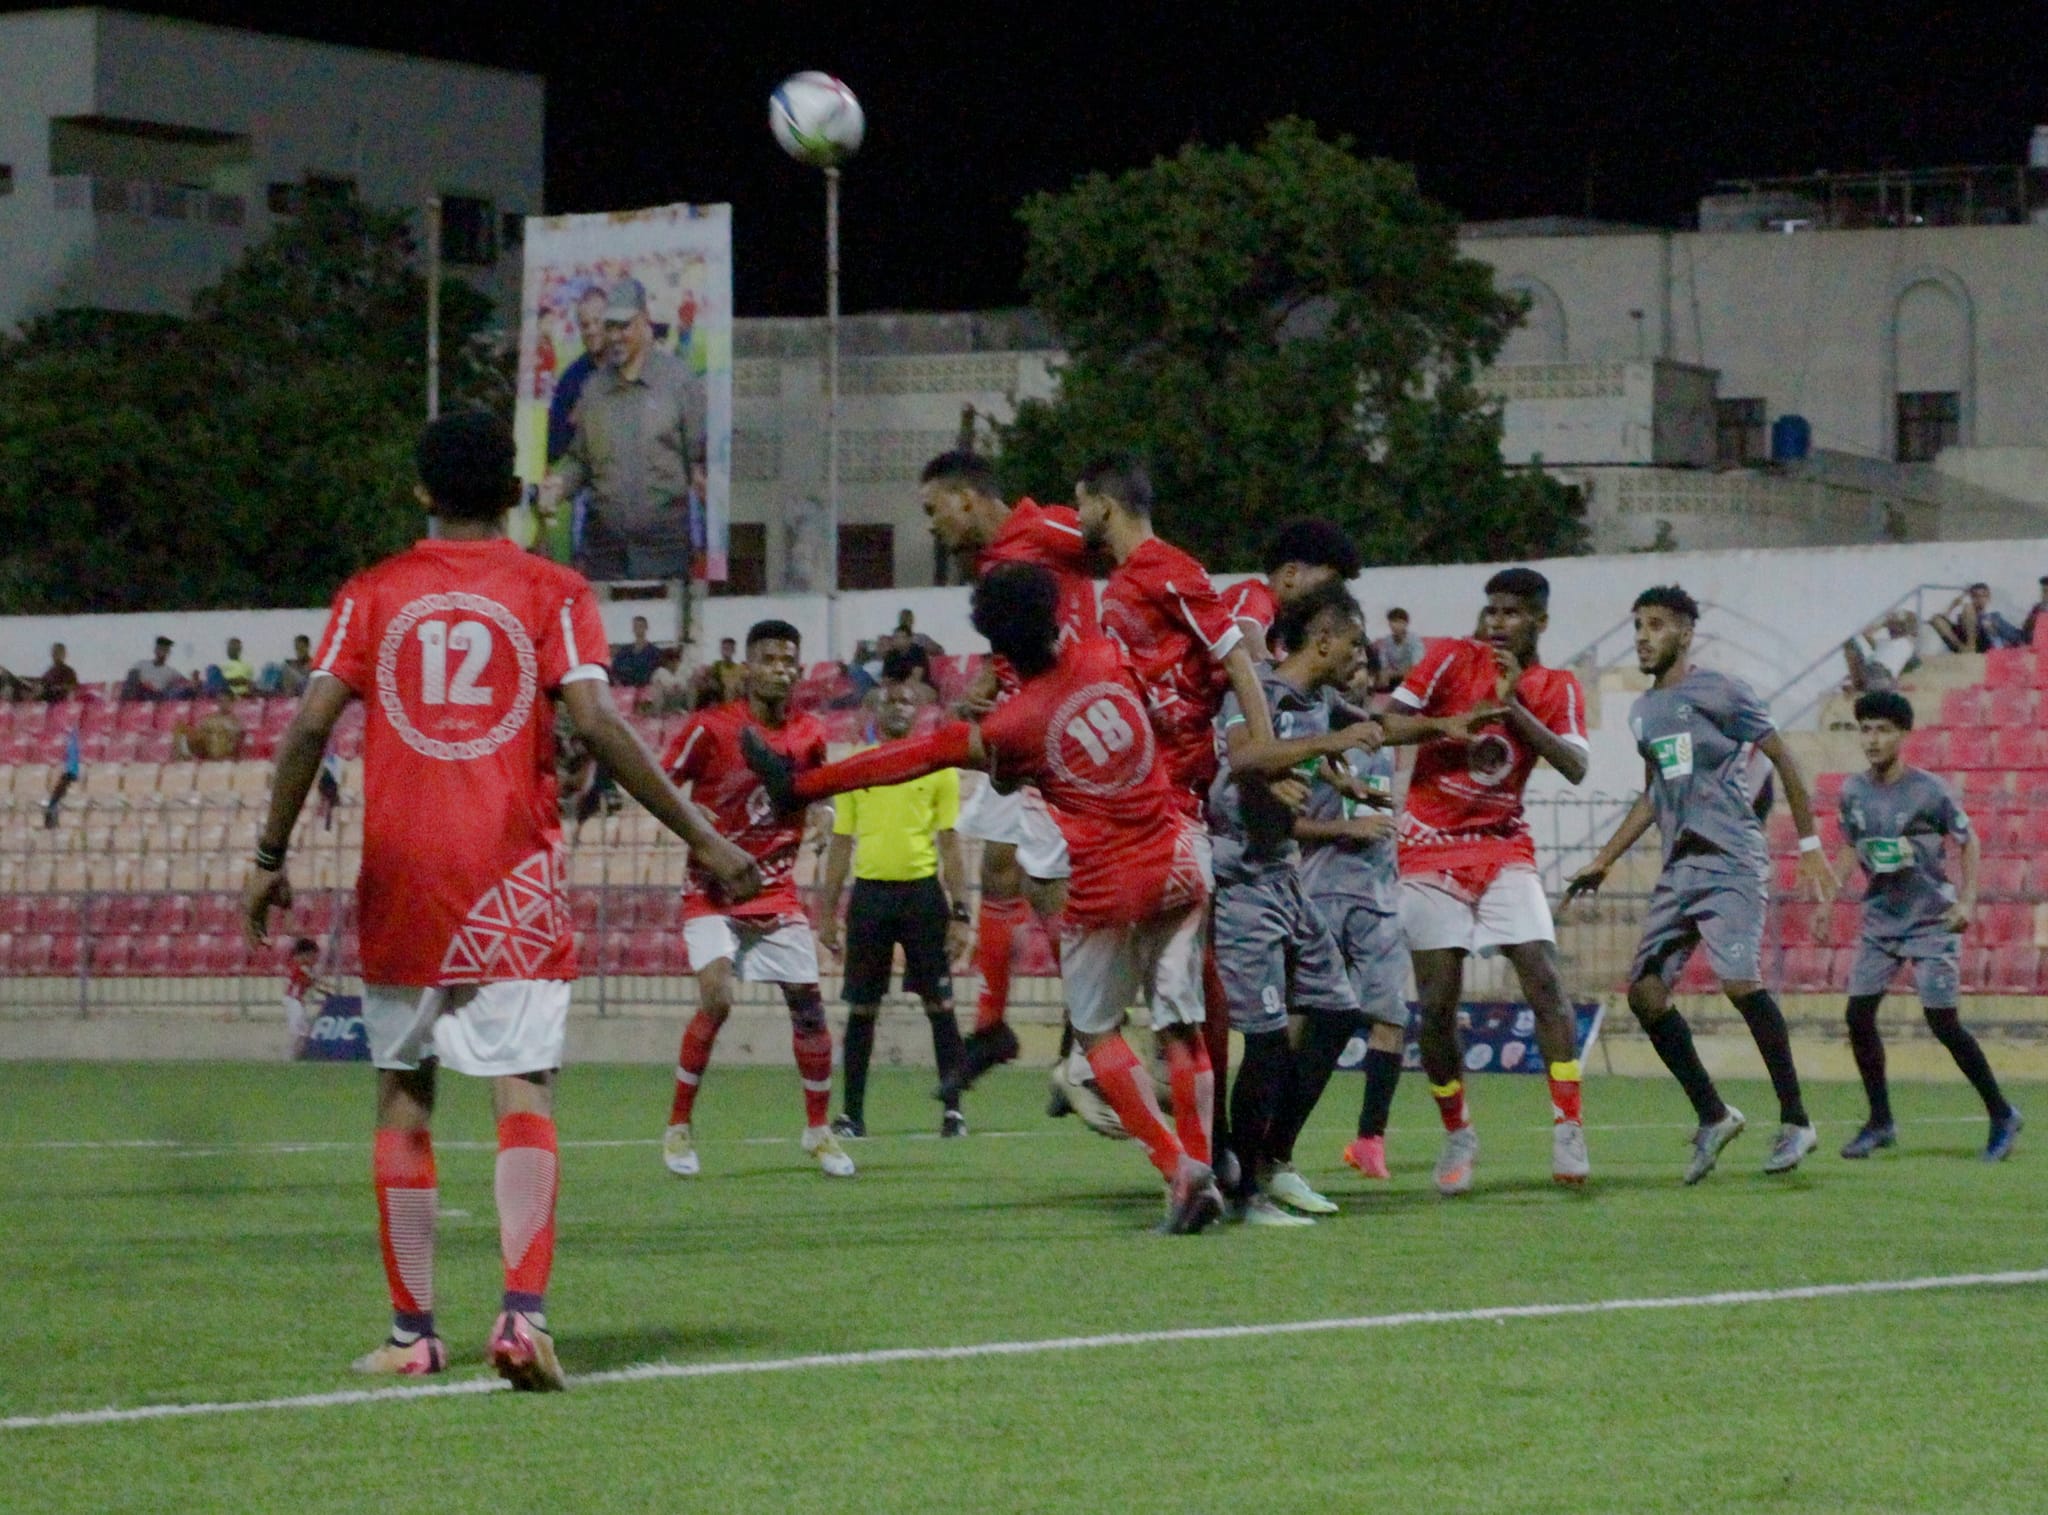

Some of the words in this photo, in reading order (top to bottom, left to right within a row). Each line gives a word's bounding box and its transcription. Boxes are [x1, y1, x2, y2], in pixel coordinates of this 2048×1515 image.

[417, 620, 493, 705] 12
[1067, 698, 1134, 766] 18
[1261, 985, 1280, 1014] 9
